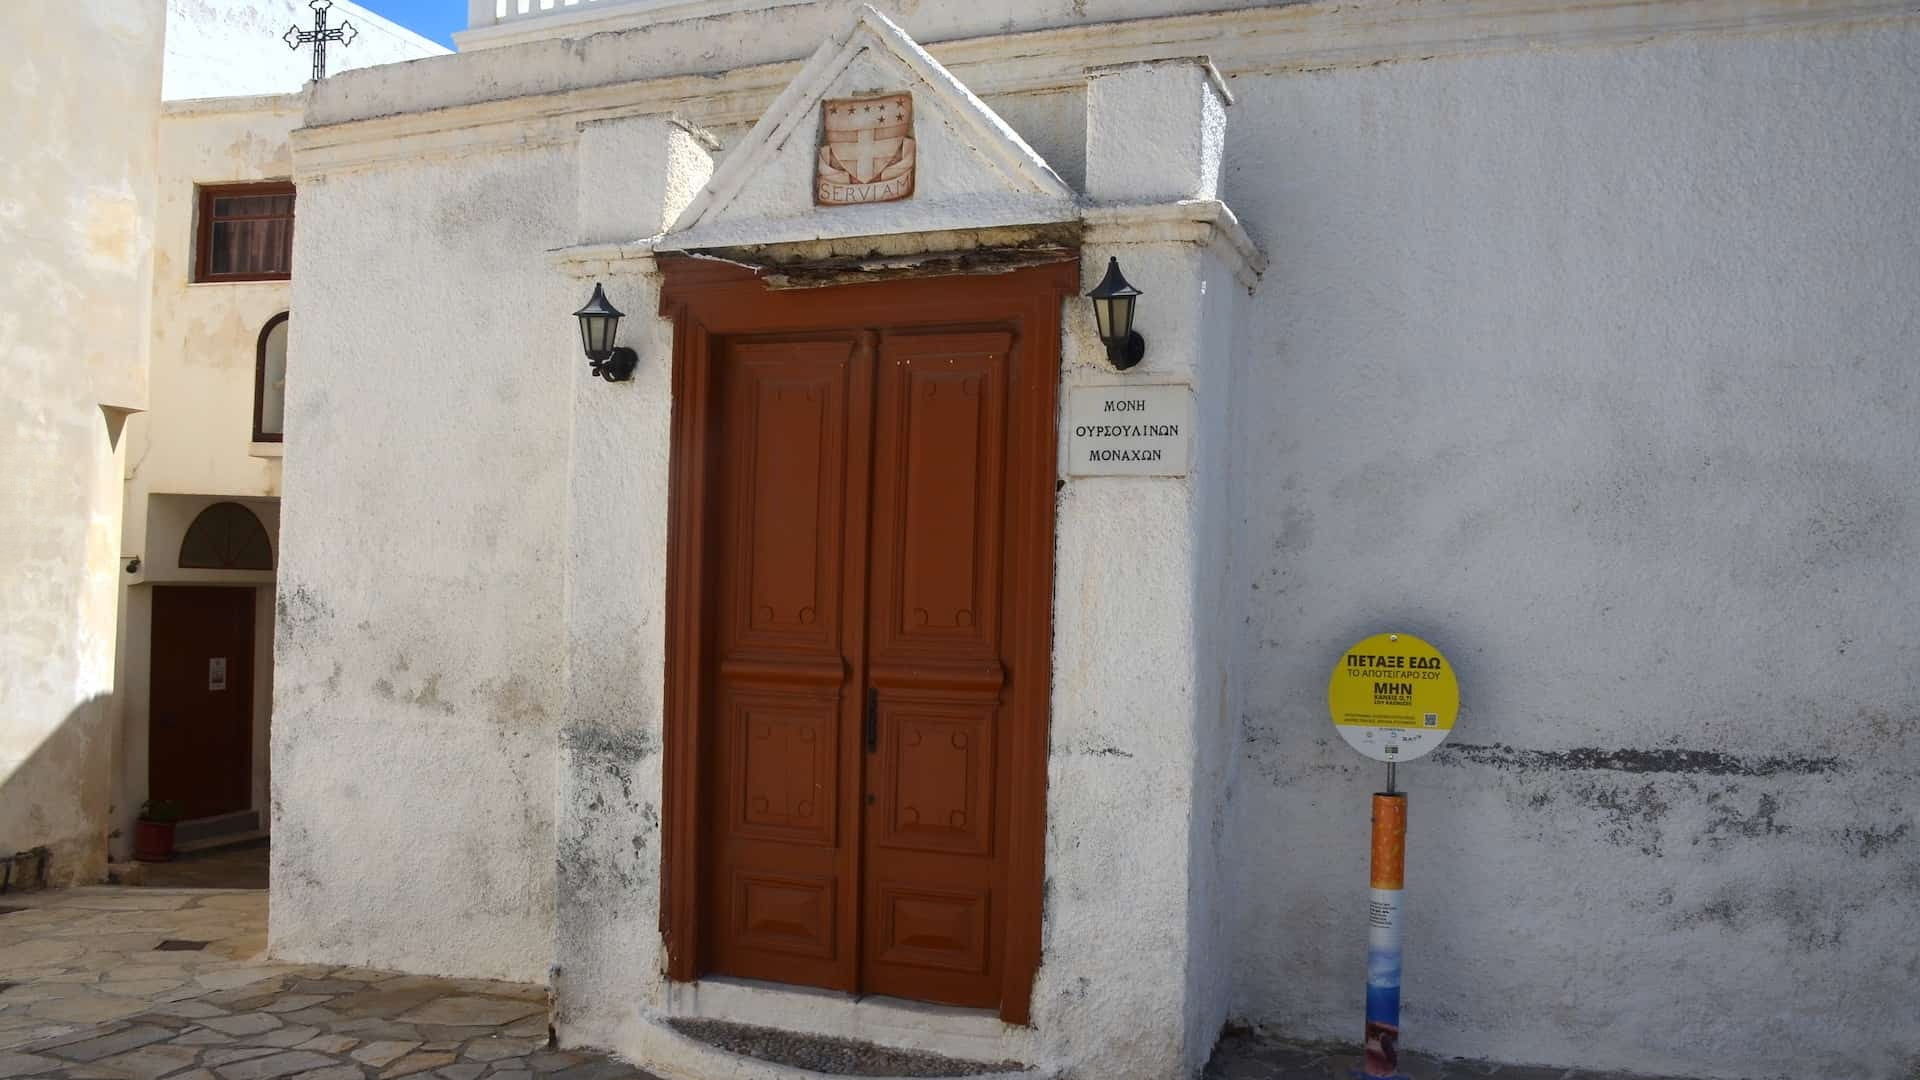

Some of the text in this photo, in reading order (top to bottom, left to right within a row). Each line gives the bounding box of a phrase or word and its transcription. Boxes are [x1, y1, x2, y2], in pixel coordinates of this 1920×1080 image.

[1104, 400, 1145, 412] ΜΟΝΗ
[1076, 425, 1179, 437] ΟΥΡΣΟΥΛΙΝΩΝ
[1089, 449, 1161, 461] ΜΟΝΑΧΩΝ
[1347, 655, 1440, 669] ΠΕΤΑΞΕ ΕΔΩ
[1348, 669, 1360, 678] ΤΟ
[1422, 672, 1440, 680] ΣΟΥ
[1374, 683, 1412, 695] ΜΗΝ
